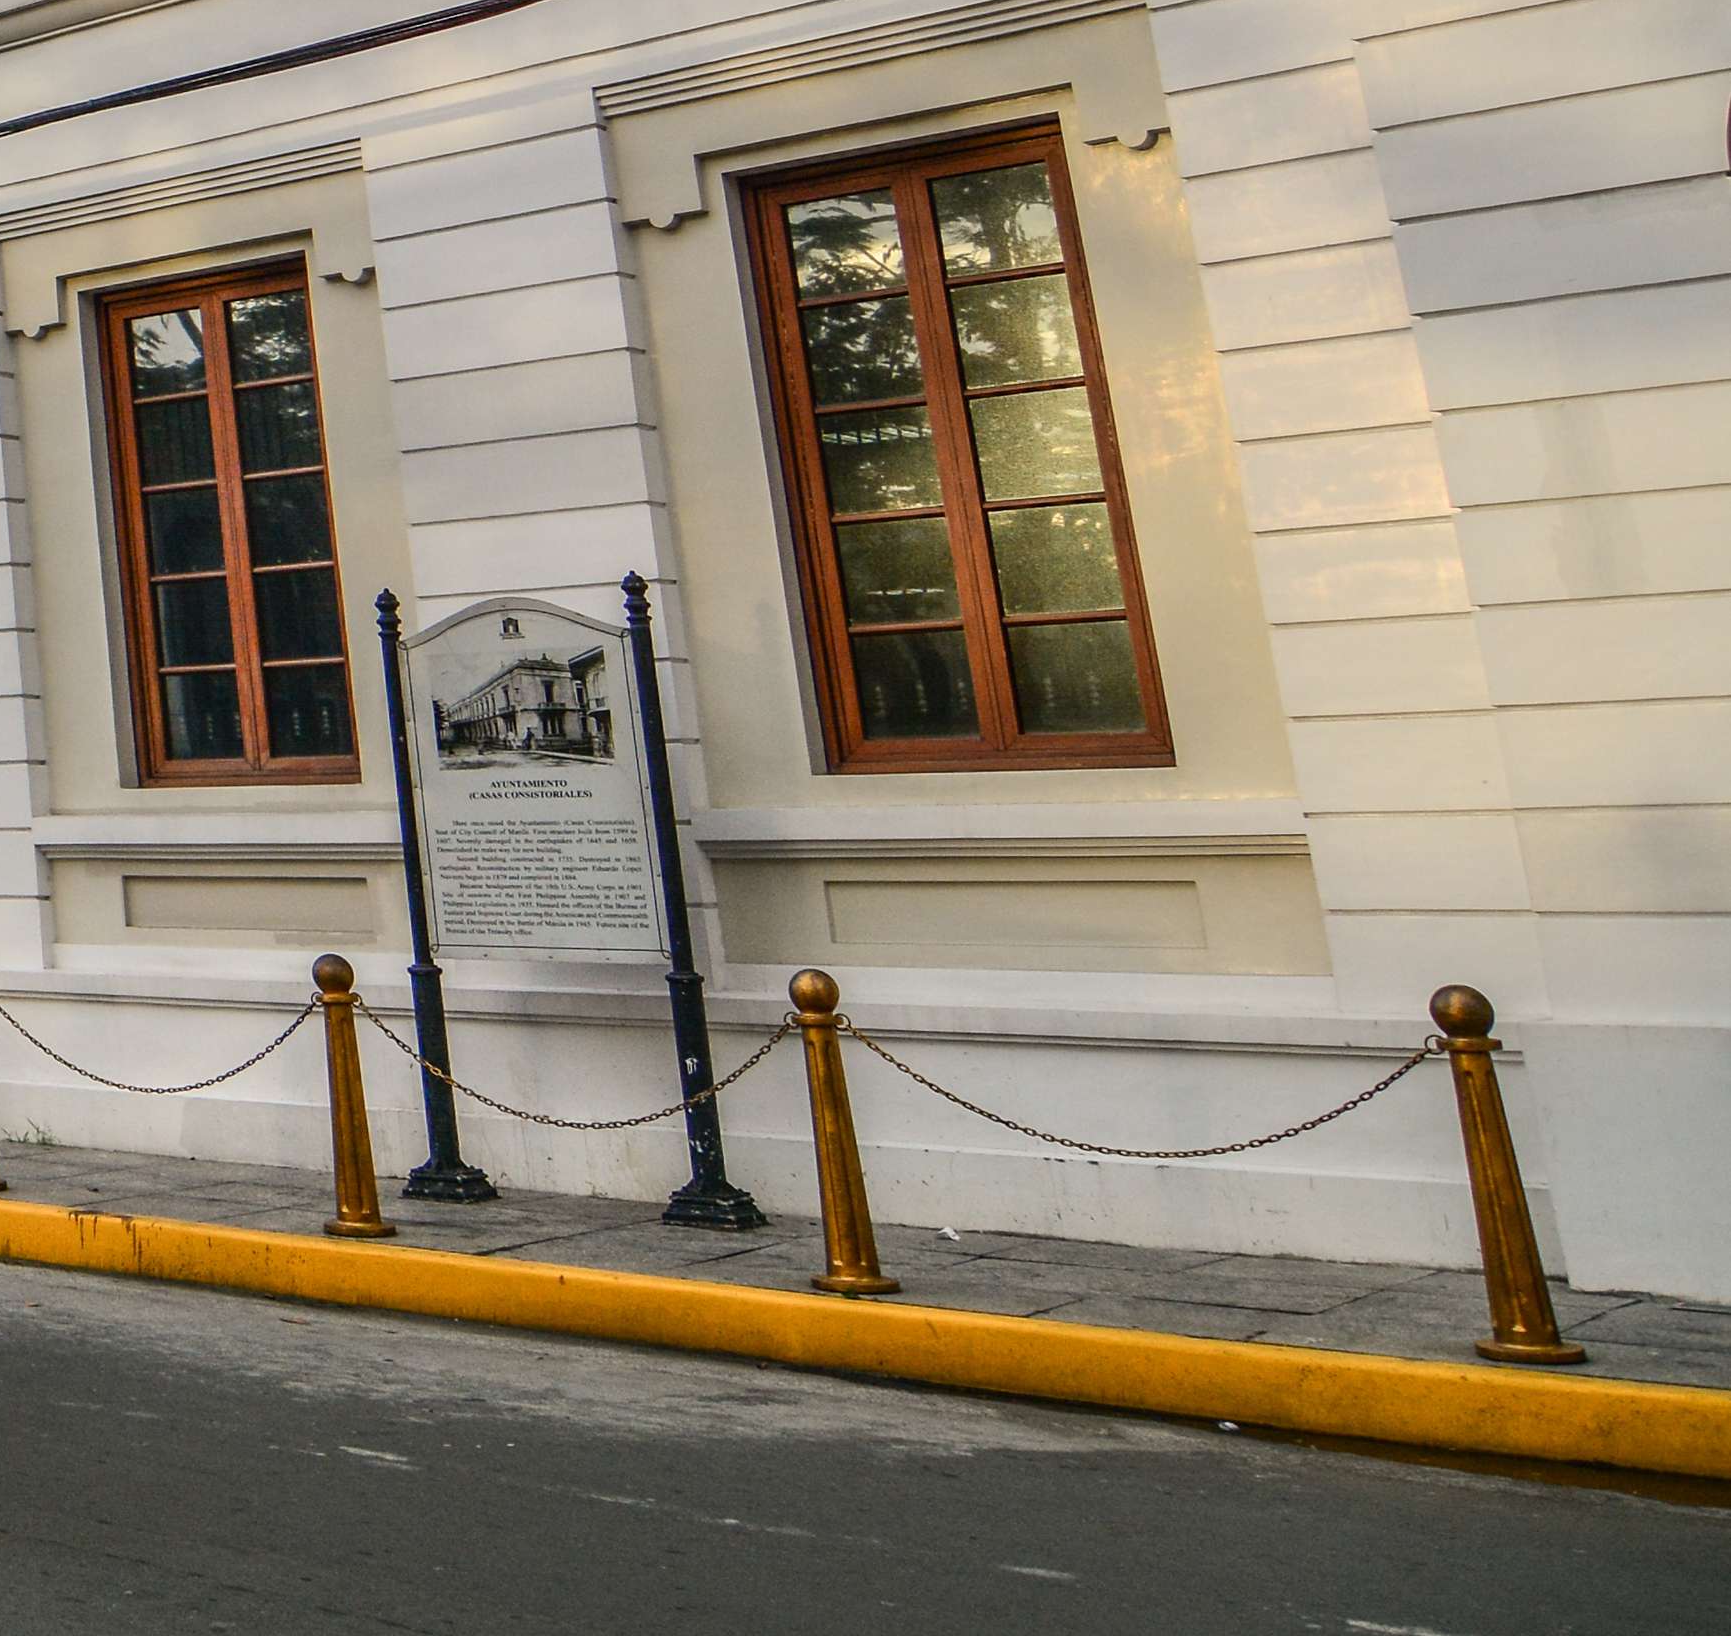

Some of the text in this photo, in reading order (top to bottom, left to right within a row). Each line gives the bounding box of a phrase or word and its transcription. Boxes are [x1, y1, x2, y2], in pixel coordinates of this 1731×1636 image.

[490, 780, 568, 788] AYUNTAMIENTO
[468, 789, 593, 800] (CASAS CONSISTORIALES)
